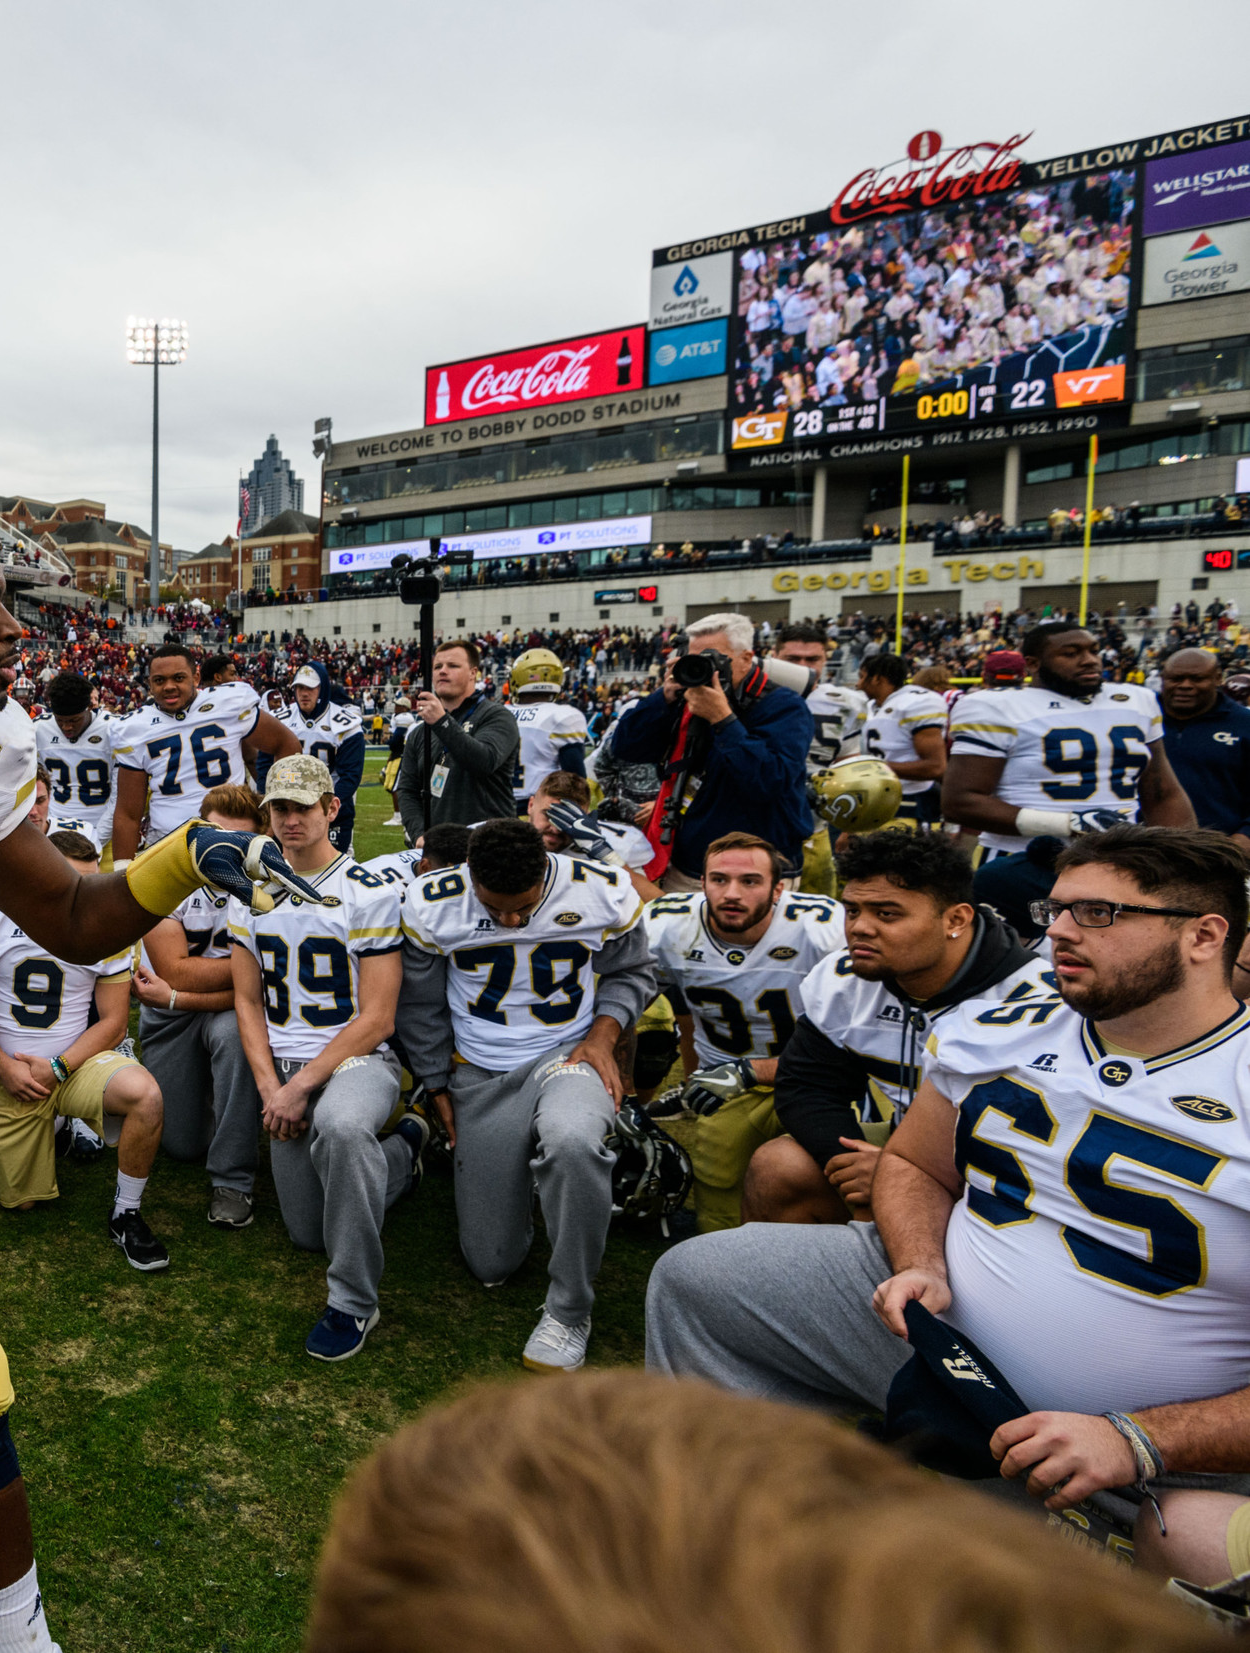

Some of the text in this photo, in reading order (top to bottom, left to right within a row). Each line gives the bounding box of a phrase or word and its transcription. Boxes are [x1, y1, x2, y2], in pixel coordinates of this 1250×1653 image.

[1036, 143, 1139, 180] YELLOW
[830, 130, 1035, 224] Coca-Cola
[666, 217, 806, 262] GEORGIA TECH
[1163, 262, 1239, 285] Georgia
[1171, 279, 1229, 298] Power
[653, 306, 722, 326] Natural Gas
[662, 297, 709, 315] Georgia
[679, 339, 721, 359] AT&T
[461, 343, 600, 410] Coca-Cola
[1066, 373, 1113, 394] VT
[916, 390, 969, 420] 0:00
[980, 396, 993, 413] 4
[1010, 379, 1046, 409] 22
[356, 392, 681, 458] WELCOME TO BOBBY DODD STADIUM
[739, 416, 782, 440] GT
[793, 409, 824, 437] 28
[750, 449, 822, 468] NATIONAL
[830, 435, 924, 458] CHAMPIONS
[1056, 415, 1099, 431] 1990
[576, 524, 638, 540] SOLUTIONS
[943, 555, 1045, 584] Tech
[512, 708, 538, 722] NES
[1213, 731, 1239, 746] GT
[146, 723, 232, 796] 76
[1041, 725, 1152, 802] 96
[44, 758, 112, 807] 38
[277, 769, 302, 784] GT
[559, 913, 580, 922] ACC
[10, 956, 66, 1030] 9
[255, 933, 357, 1029] 89
[452, 941, 592, 1027] 79
[685, 986, 796, 1058] 31
[1103, 1065, 1128, 1084] GT
[1178, 1099, 1230, 1117] ACC
[954, 1075, 1230, 1300] 65
[951, 1343, 996, 1389] RUSSELL
